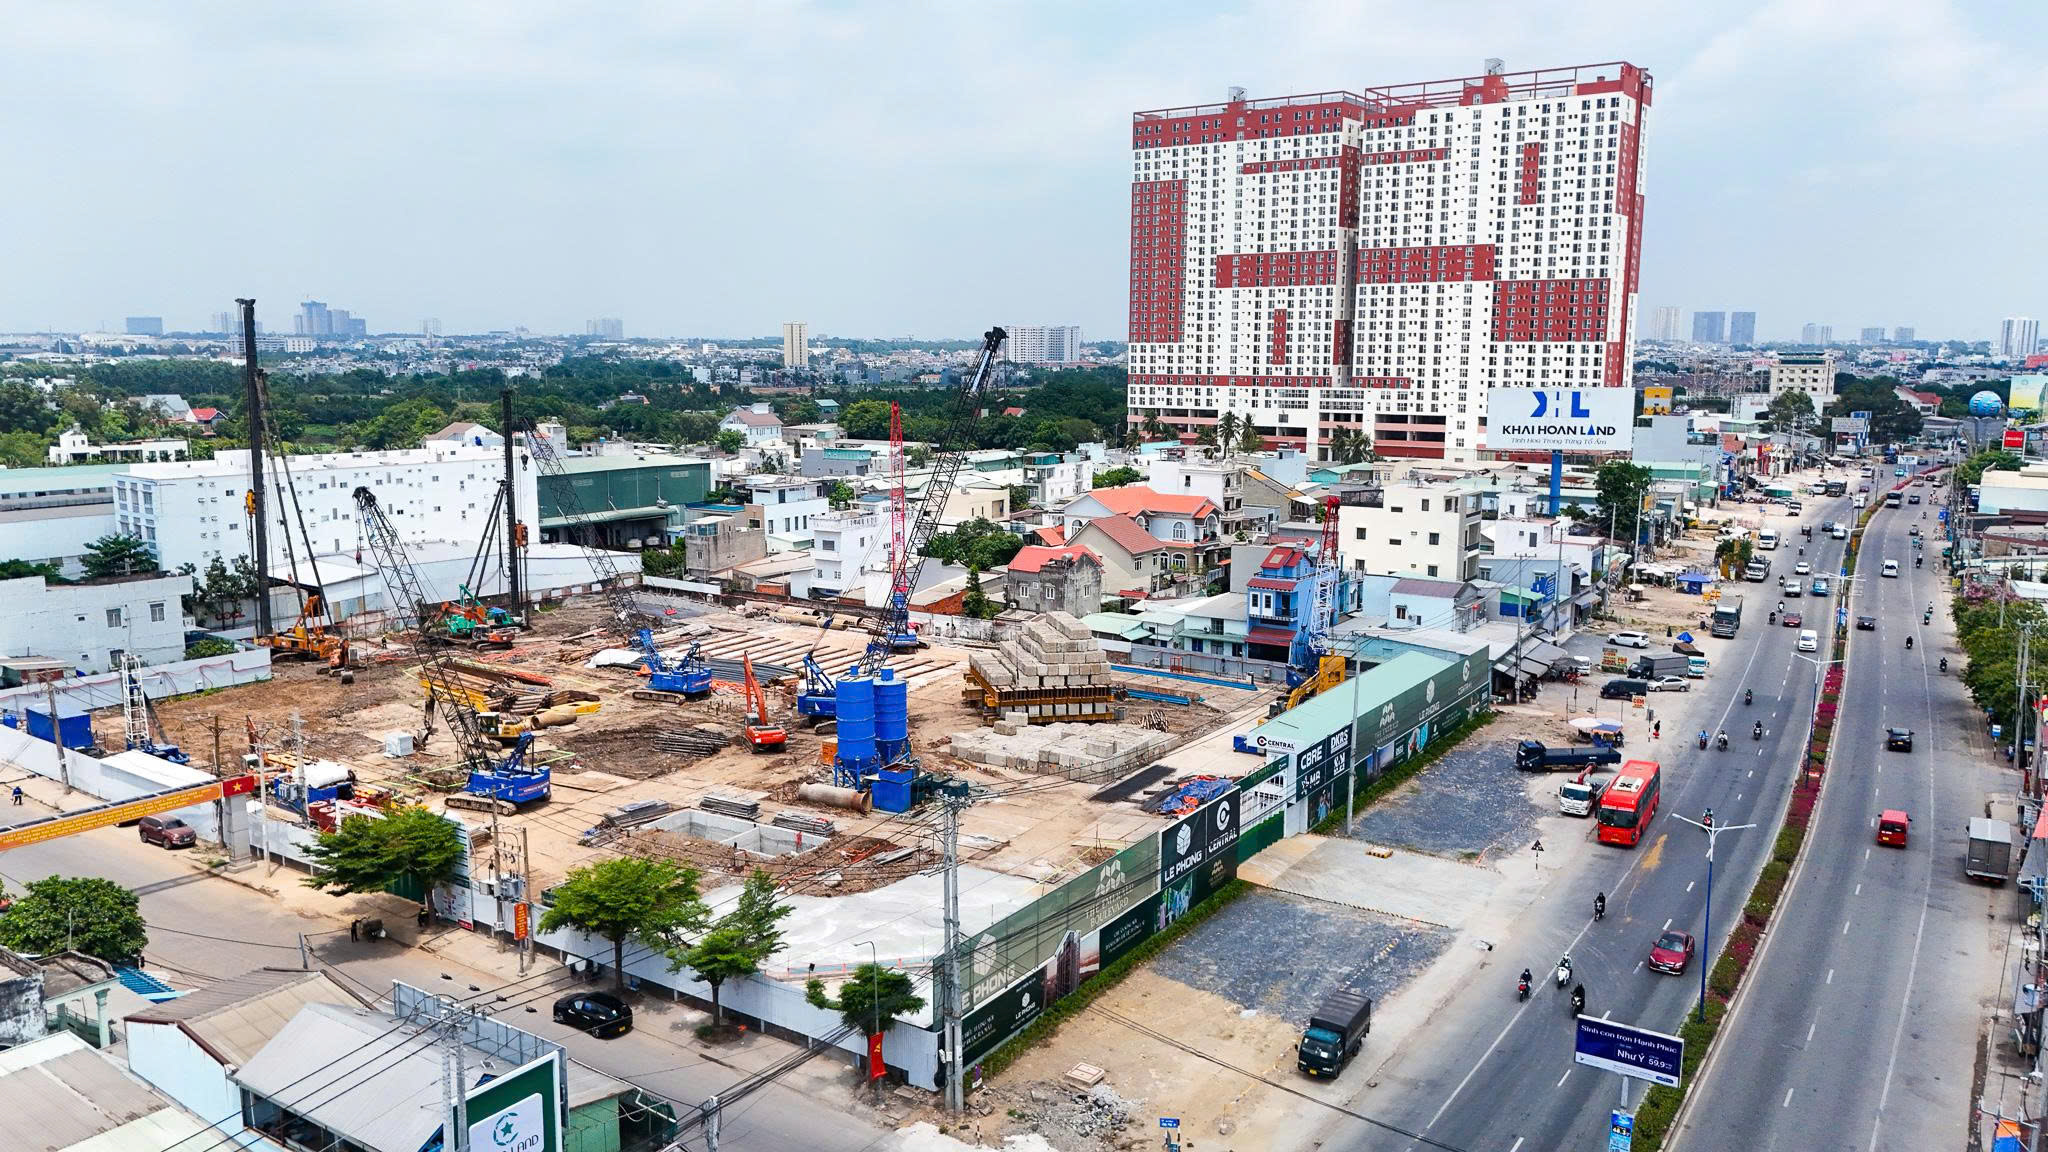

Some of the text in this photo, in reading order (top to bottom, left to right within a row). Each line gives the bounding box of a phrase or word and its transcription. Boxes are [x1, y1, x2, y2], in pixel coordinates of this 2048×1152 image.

[1502, 424, 1616, 436] KHAI HOAN LAND
[1267, 740, 1295, 750] CENTRAL
[1300, 745, 1323, 770] CBRE
[1208, 829, 1238, 853] CENTRAL
[1164, 850, 1203, 882] LE PHONG
[961, 993, 970, 1010] E
[973, 965, 1015, 1003] PHONG
[1580, 1024, 1599, 1035] Sinh
[1599, 1030, 1616, 1039] con
[1617, 1049, 1637, 1061] Như
